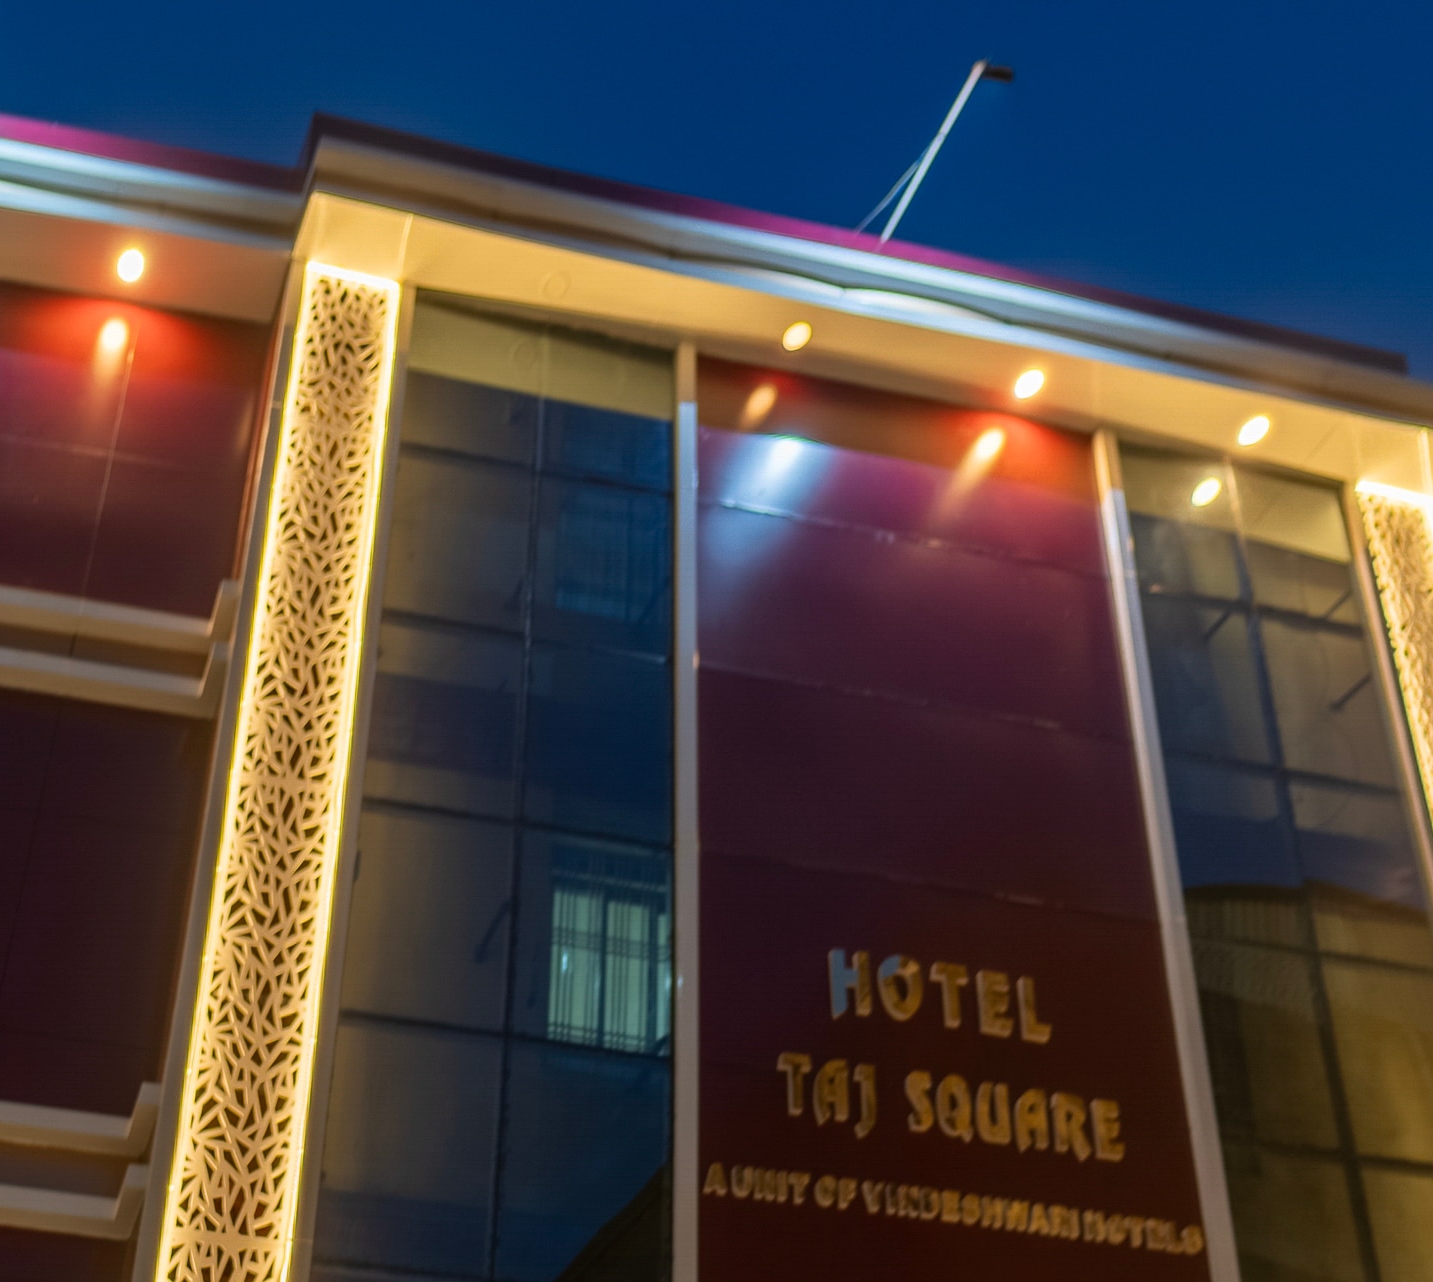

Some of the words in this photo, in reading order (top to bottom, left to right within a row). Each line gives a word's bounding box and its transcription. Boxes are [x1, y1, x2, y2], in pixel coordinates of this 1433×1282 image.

[828, 947, 1052, 1045] HOTEL
[777, 1051, 877, 1139] TAJ
[904, 1068, 1126, 1163] SQUARE
[703, 1162, 728, 1197] A
[731, 1164, 811, 1206] UNIT
[814, 1174, 858, 1211] OF
[1083, 1208, 1204, 1257] HOTELS
